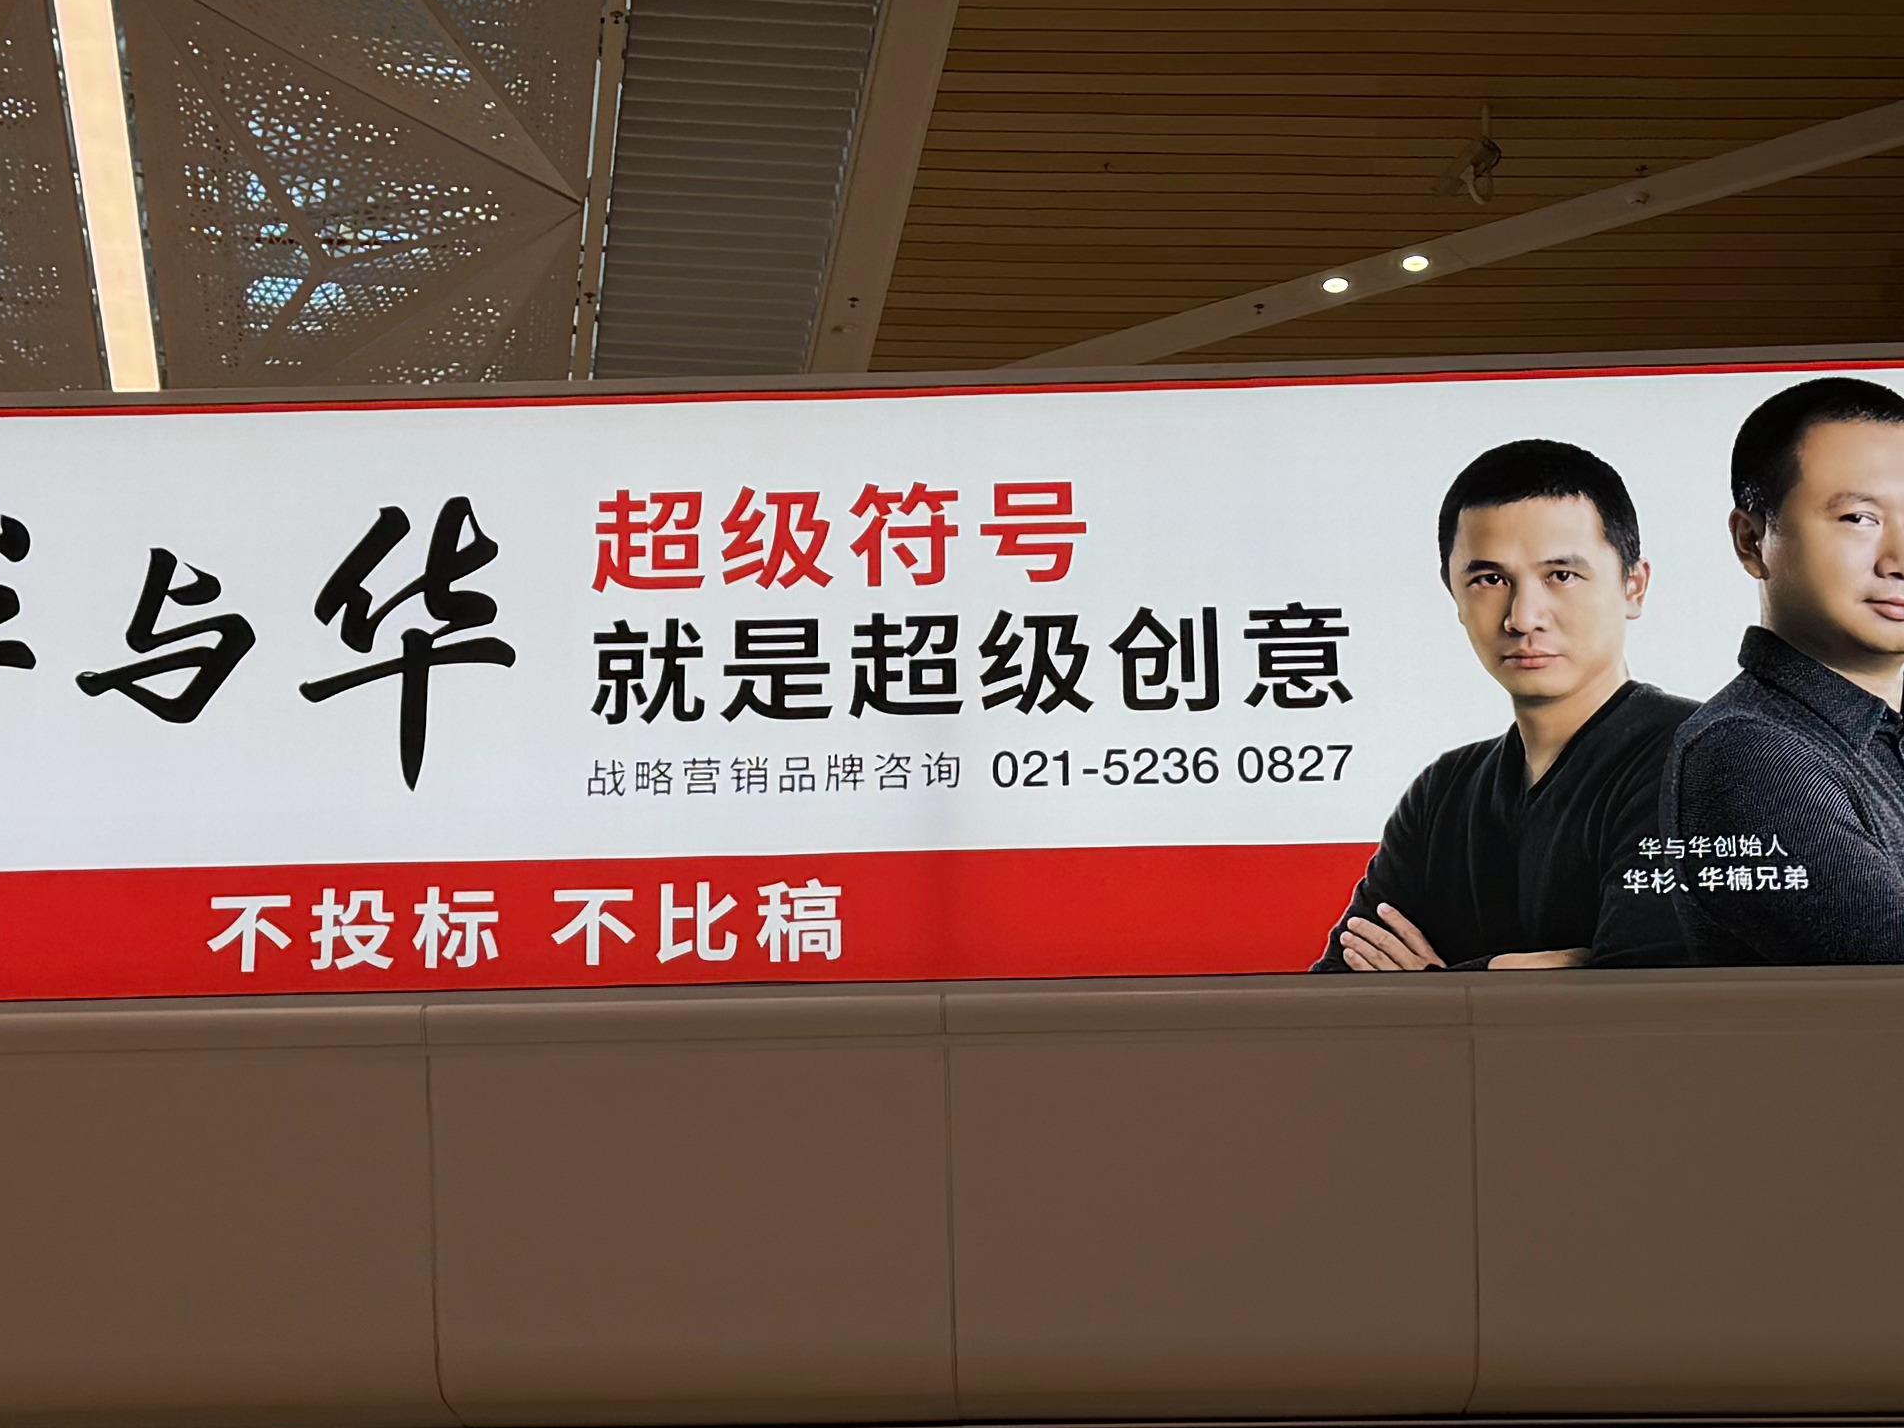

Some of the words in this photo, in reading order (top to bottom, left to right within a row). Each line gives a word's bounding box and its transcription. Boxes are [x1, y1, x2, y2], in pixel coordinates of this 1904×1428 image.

[590, 480, 1088, 593] 超级符号
[590, 601, 1354, 725] 就是超级创意
[586, 751, 962, 797] 战略营销品牌咨询
[990, 746, 1220, 789] 021-5236
[1235, 744, 1354, 785] 0827
[1622, 864, 1809, 894] 华杉、华楠兄弟
[1638, 833, 1789, 860] 华与华创始人
[206, 886, 500, 973] 不投标
[551, 877, 843, 966] 不比稿
